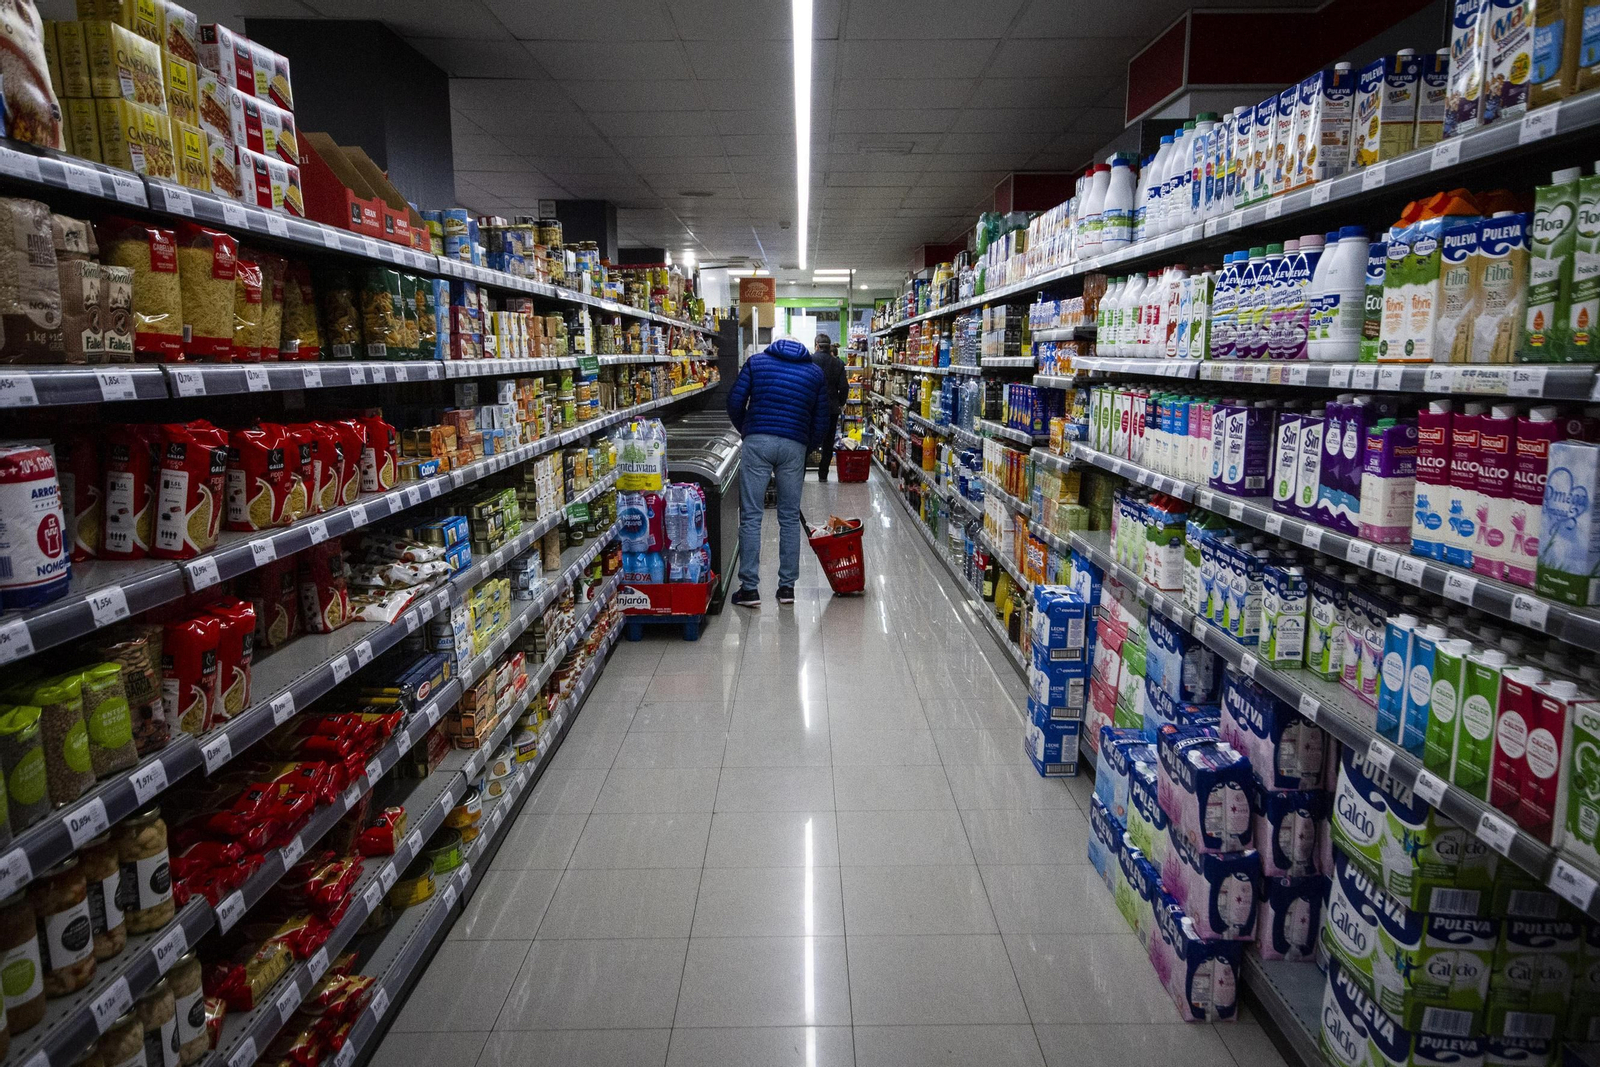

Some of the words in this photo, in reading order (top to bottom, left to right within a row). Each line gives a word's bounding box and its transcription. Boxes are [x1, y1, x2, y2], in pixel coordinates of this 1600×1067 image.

[1361, 65, 1383, 84] PULEVA
[246, 109, 258, 118] GALLO
[179, 159, 208, 178] LASAÑA
[256, 166, 267, 175] GALLO
[1482, 224, 1521, 242] PULEVA
[1534, 219, 1563, 231] Flora
[1443, 231, 1477, 249] PULEVA
[1445, 266, 1470, 287] Fibra
[1484, 261, 1514, 283] Fibra
[33, 331, 46, 344] kg
[109, 337, 131, 350] Fallera
[1230, 417, 1243, 434] Sin
[1283, 425, 1297, 444] Sin
[1305, 428, 1319, 450] Sin
[269, 462, 284, 470] GALLO
[421, 464, 435, 475] Calvo
[1365, 465, 1381, 473] LACTOSA
[1369, 458, 1378, 466] SIN
[1417, 456, 1446, 467] ALCIO
[1450, 460, 1479, 472] ALCIO
[1478, 465, 1509, 479] ALCIO
[1513, 471, 1548, 484] ALCIO
[1231, 555, 1246, 569] PULEVA
[1282, 589, 1304, 597] PULEVA
[1313, 581, 1334, 598] PULEVA
[92, 598, 112, 612] 1,55€
[617, 594, 648, 606] njarón
[1281, 604, 1302, 612] Calcio
[1312, 606, 1330, 620] Calcio
[1367, 600, 1388, 617] PULEVA
[454, 621, 466, 637] Calvo
[1150, 613, 1174, 647] PULEVA
[1364, 629, 1384, 645] Calcio
[457, 646, 469, 662] Calvo
[1413, 672, 1429, 684] CALCIO
[1435, 687, 1454, 700] CALCIO
[1227, 688, 1264, 732] PULEVA
[1469, 702, 1490, 717] CALCIO
[1503, 719, 1524, 733] CALCIO
[1531, 735, 1554, 752] CALCIO
[1161, 741, 1192, 786] PULEVA
[136, 774, 154, 789] 1,97€
[1352, 751, 1414, 811] PULEVA
[1132, 781, 1161, 823] PULEVA
[1337, 793, 1375, 839] Calcio
[1091, 807, 1114, 846] PULEVA
[1344, 862, 1406, 929] PULEVA
[1330, 902, 1367, 952] Calcio
[1433, 917, 1493, 933] PULEVA
[1513, 922, 1574, 935] PULEVA
[1336, 970, 1395, 1046] PULEVA
[1324, 1006, 1357, 1061] Calcio
[1419, 1035, 1478, 1052] PULEVA
